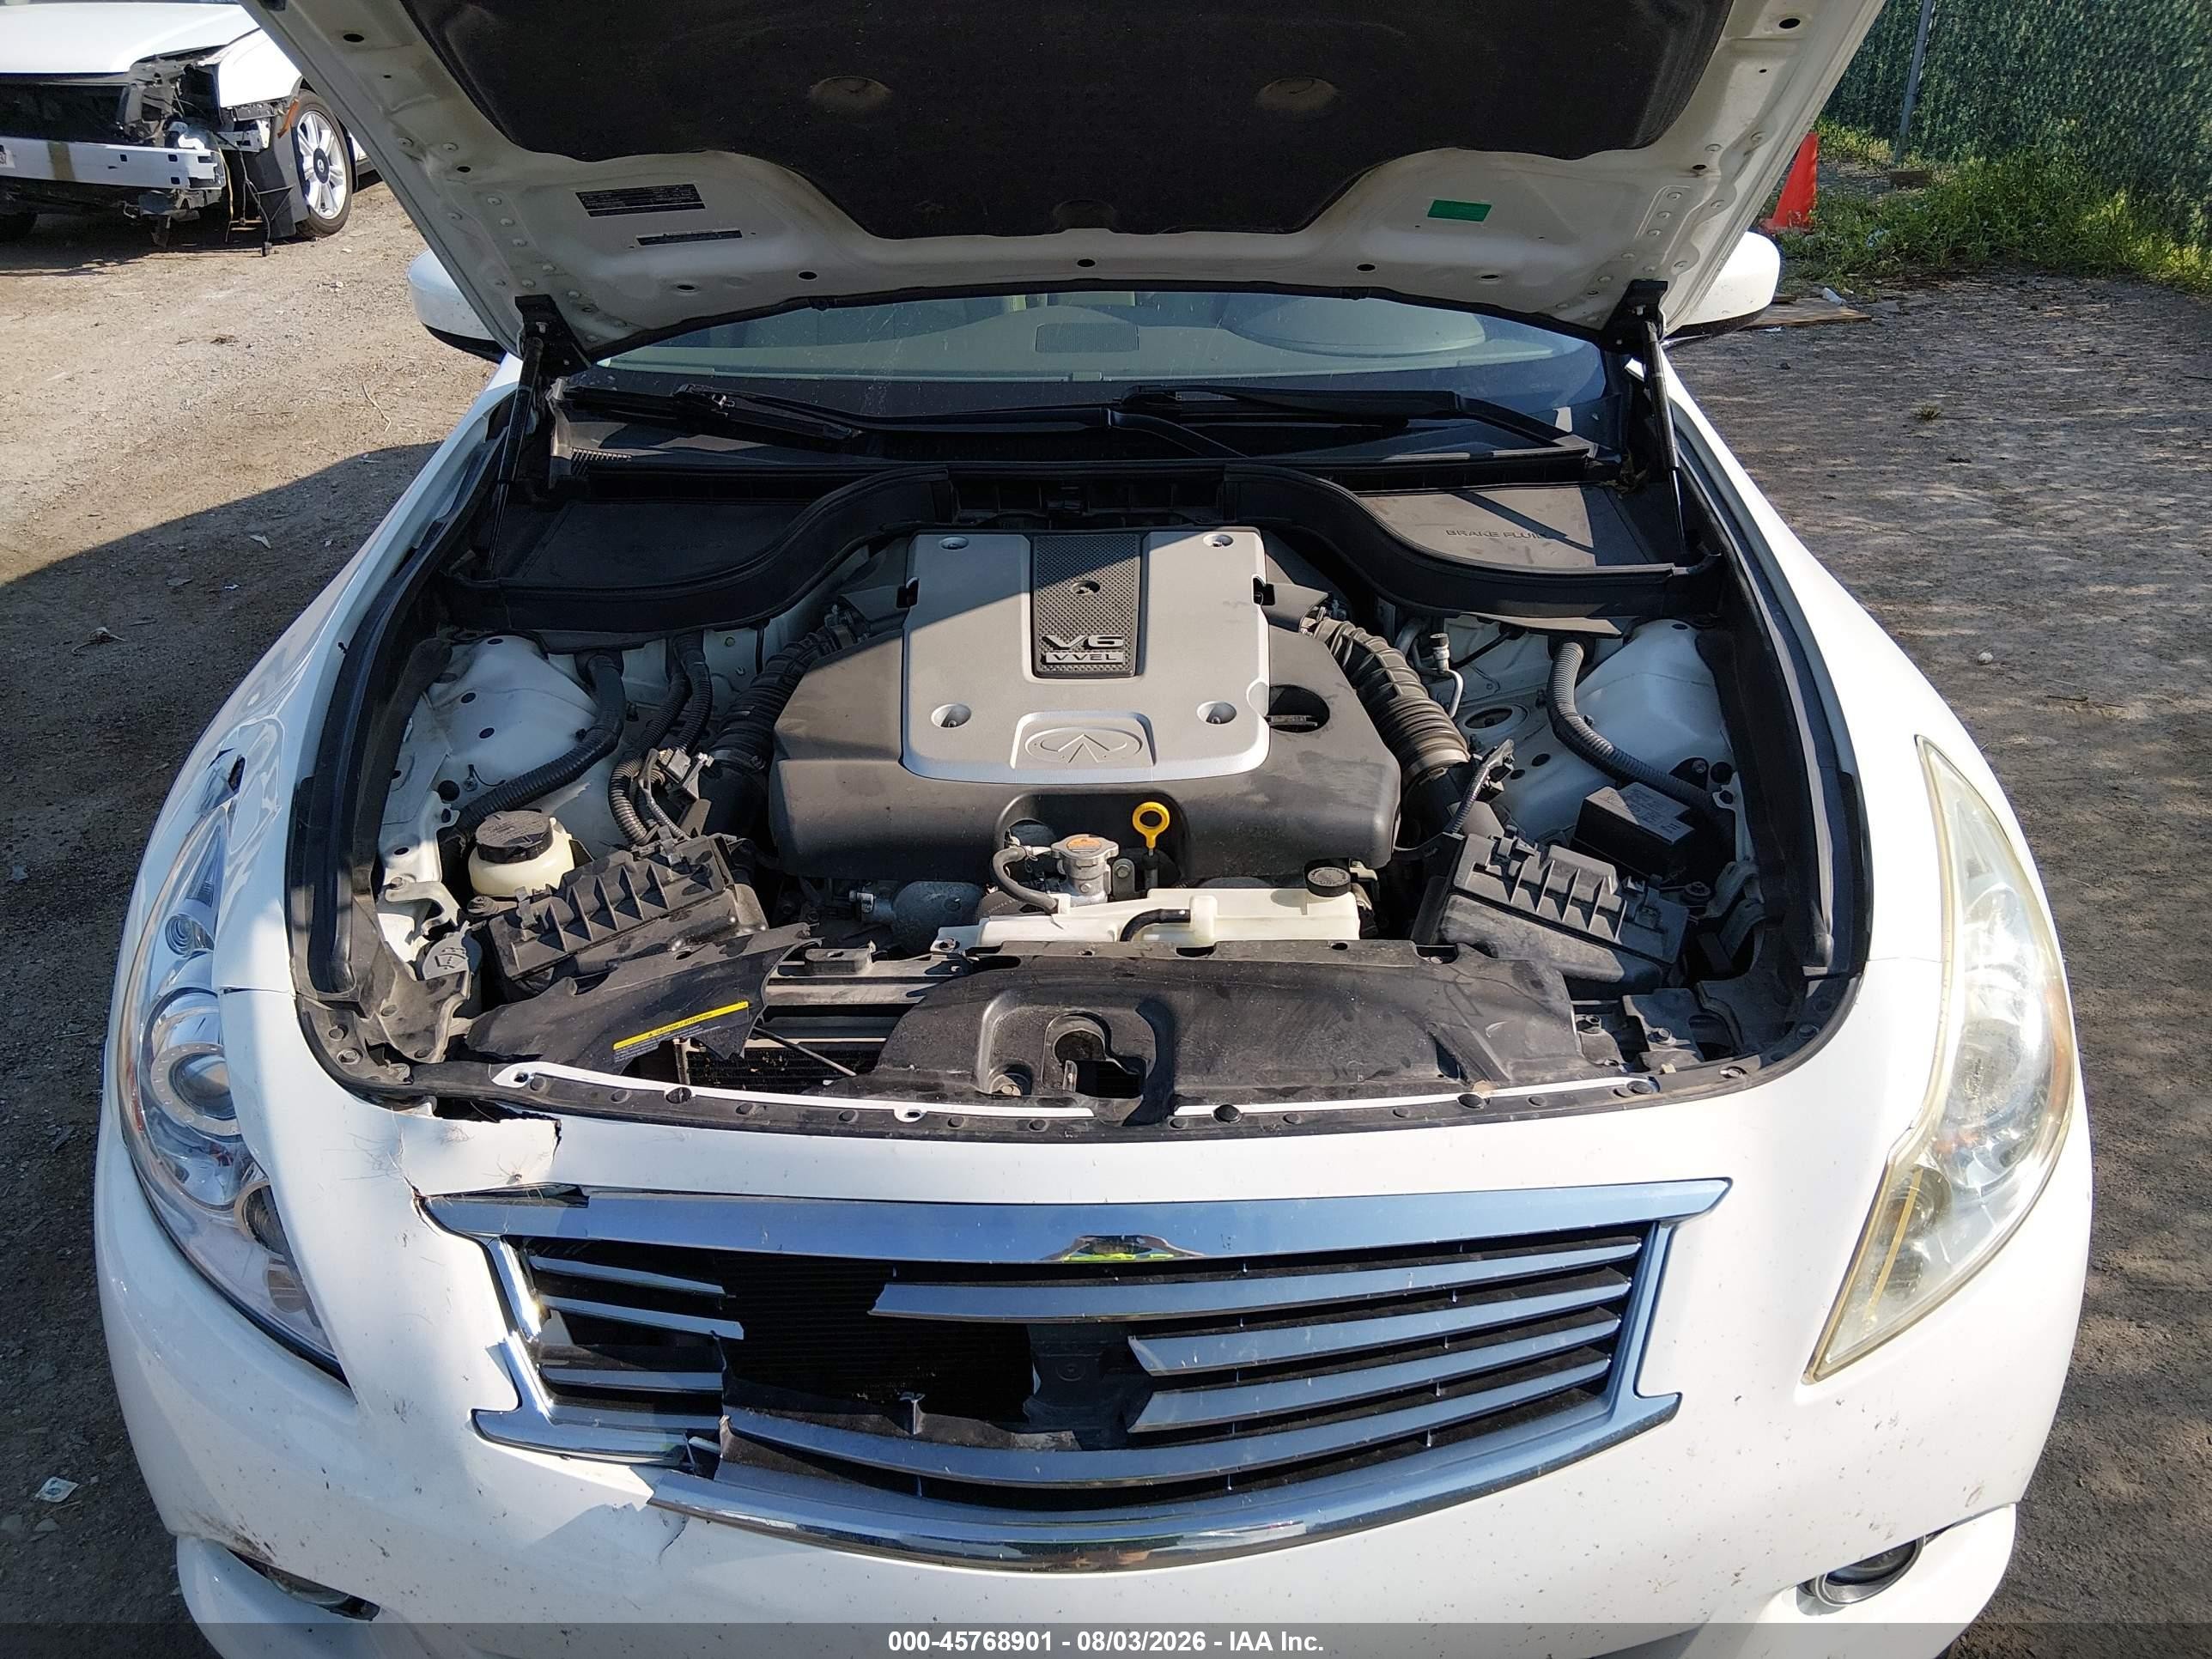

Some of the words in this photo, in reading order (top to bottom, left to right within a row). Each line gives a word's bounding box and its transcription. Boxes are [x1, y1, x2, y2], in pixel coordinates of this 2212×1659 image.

[1445, 529, 1499, 538] BRAKE
[1042, 635, 1124, 650] V6
[1052, 653, 1119, 661] VVEL
[656, 1024, 679, 1034] CAUTION
